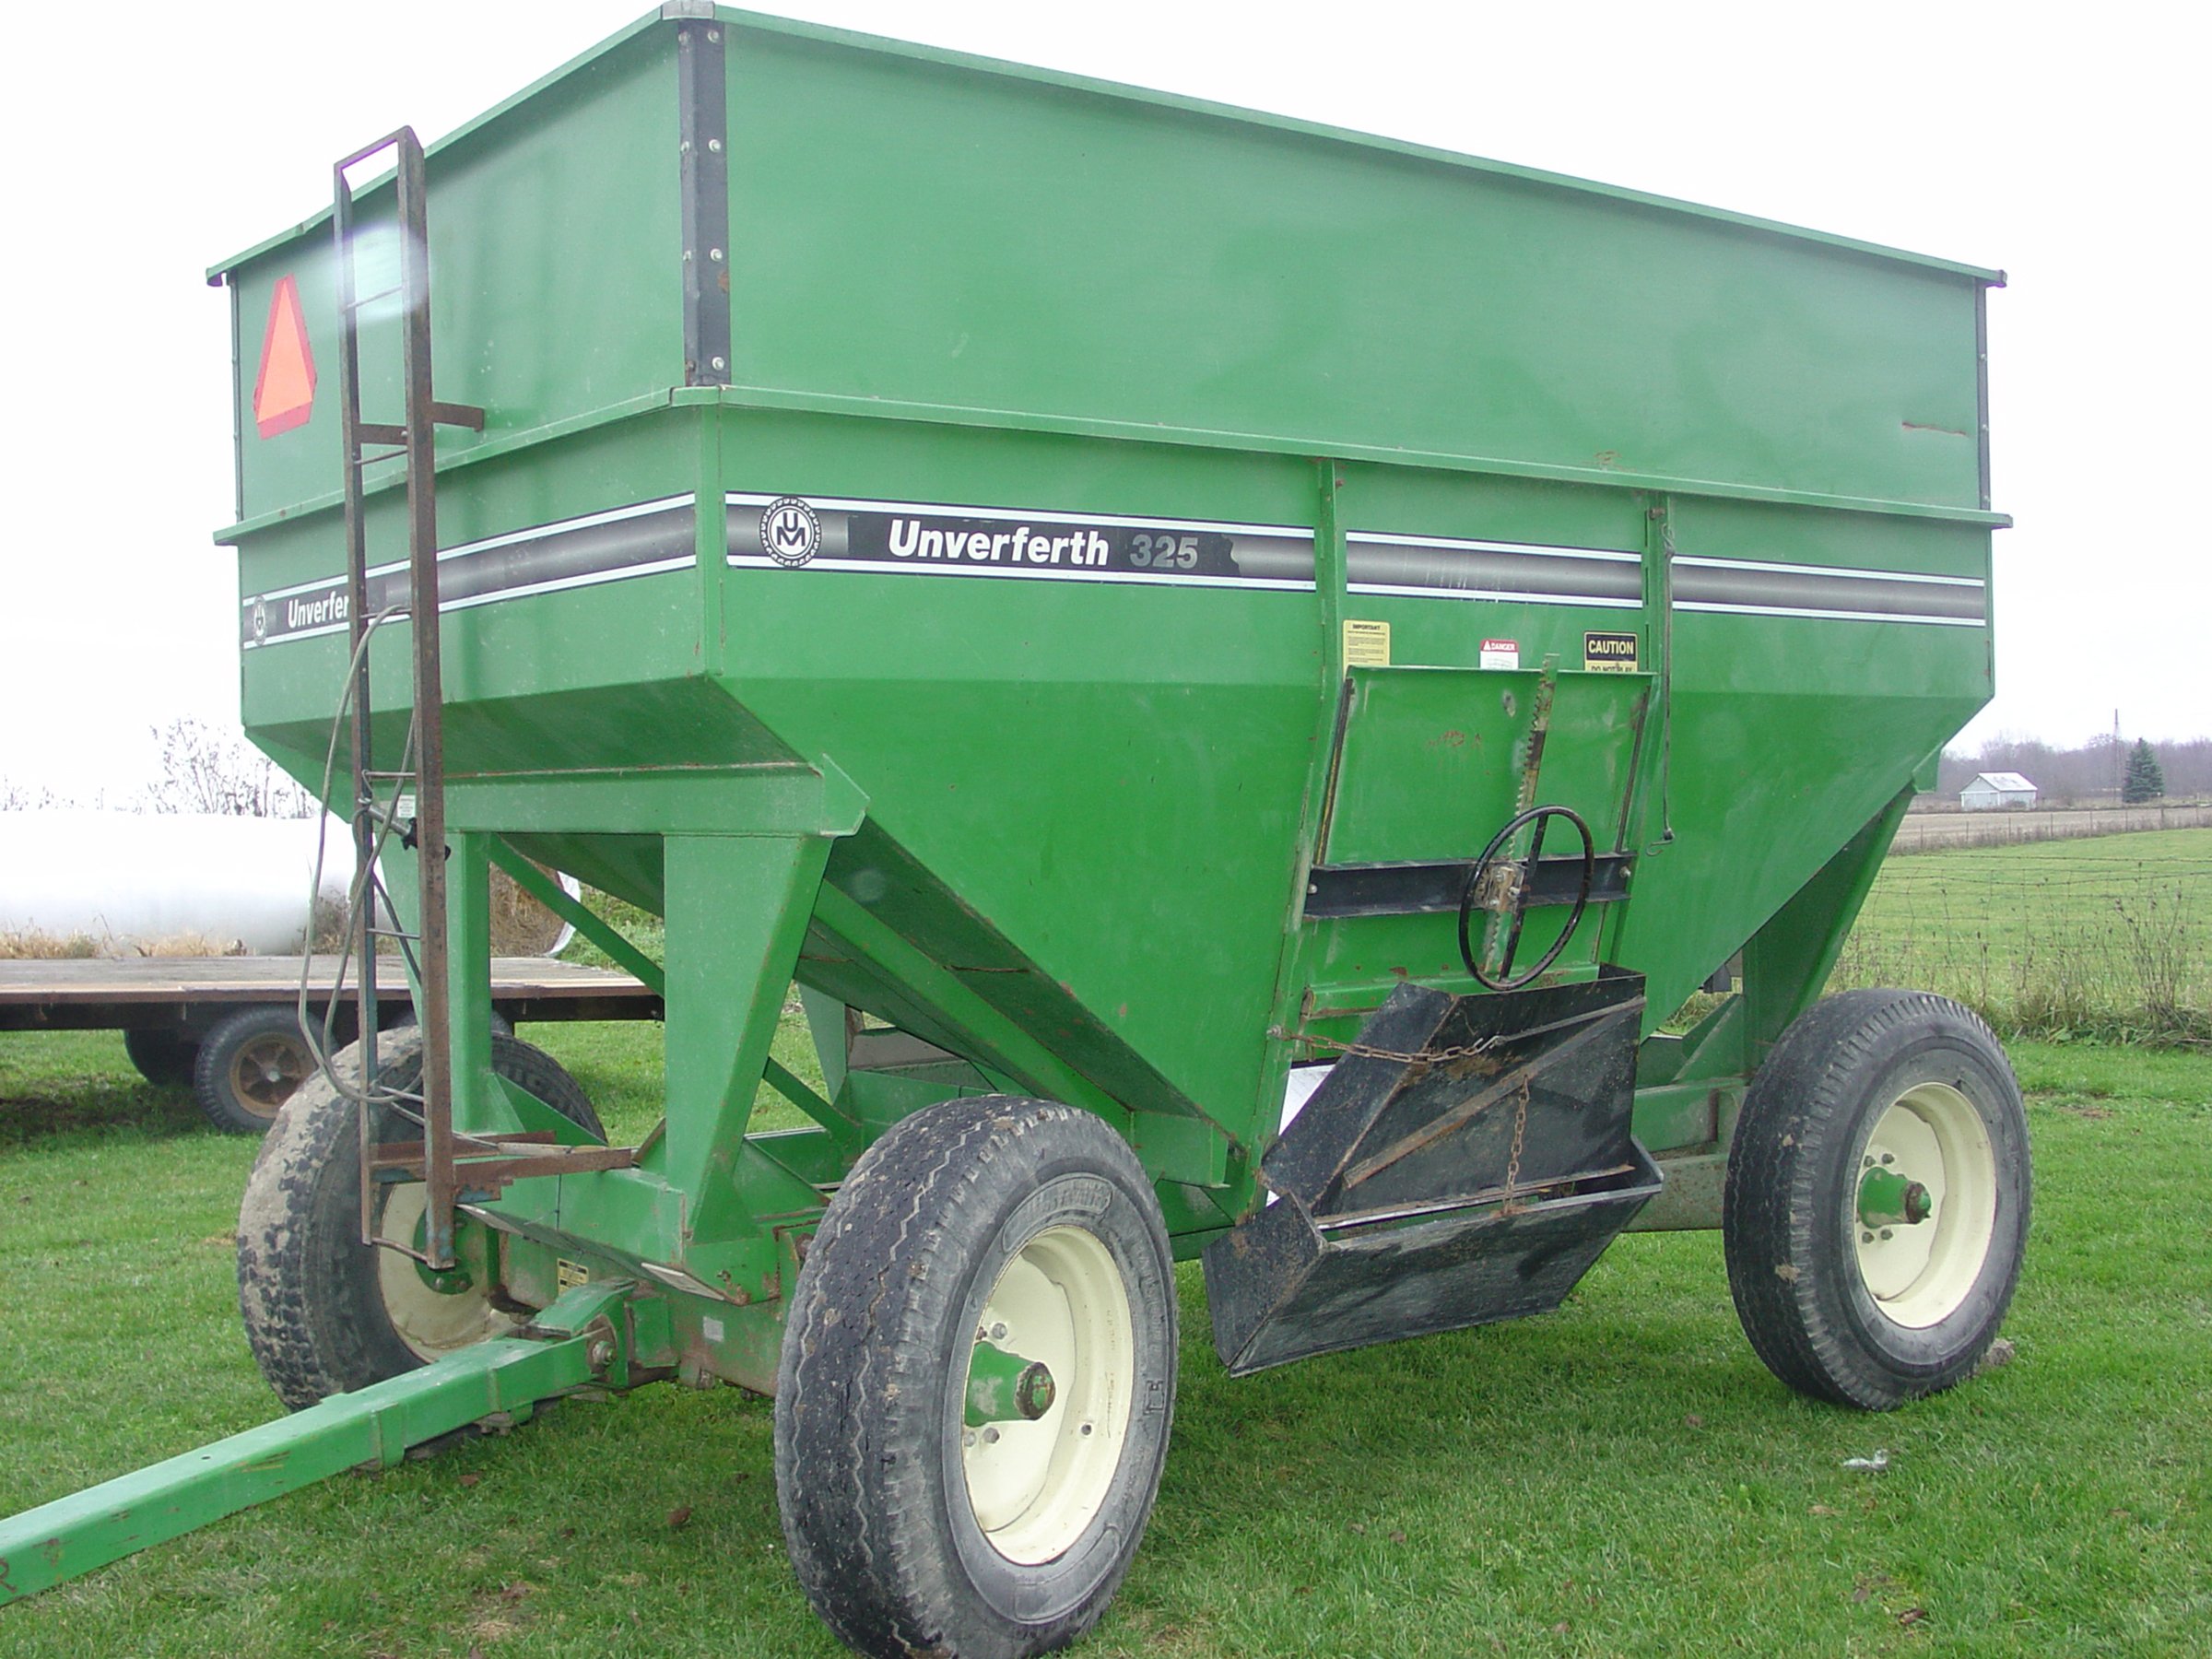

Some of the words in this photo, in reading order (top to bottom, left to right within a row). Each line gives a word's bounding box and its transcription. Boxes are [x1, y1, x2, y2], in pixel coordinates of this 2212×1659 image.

[888, 519, 1110, 566] Unverferth
[1129, 534, 1199, 569] 325
[288, 591, 350, 629] Unverfer
[1490, 642, 1516, 652] DANGER
[1588, 640, 1634, 654] CAUTION
